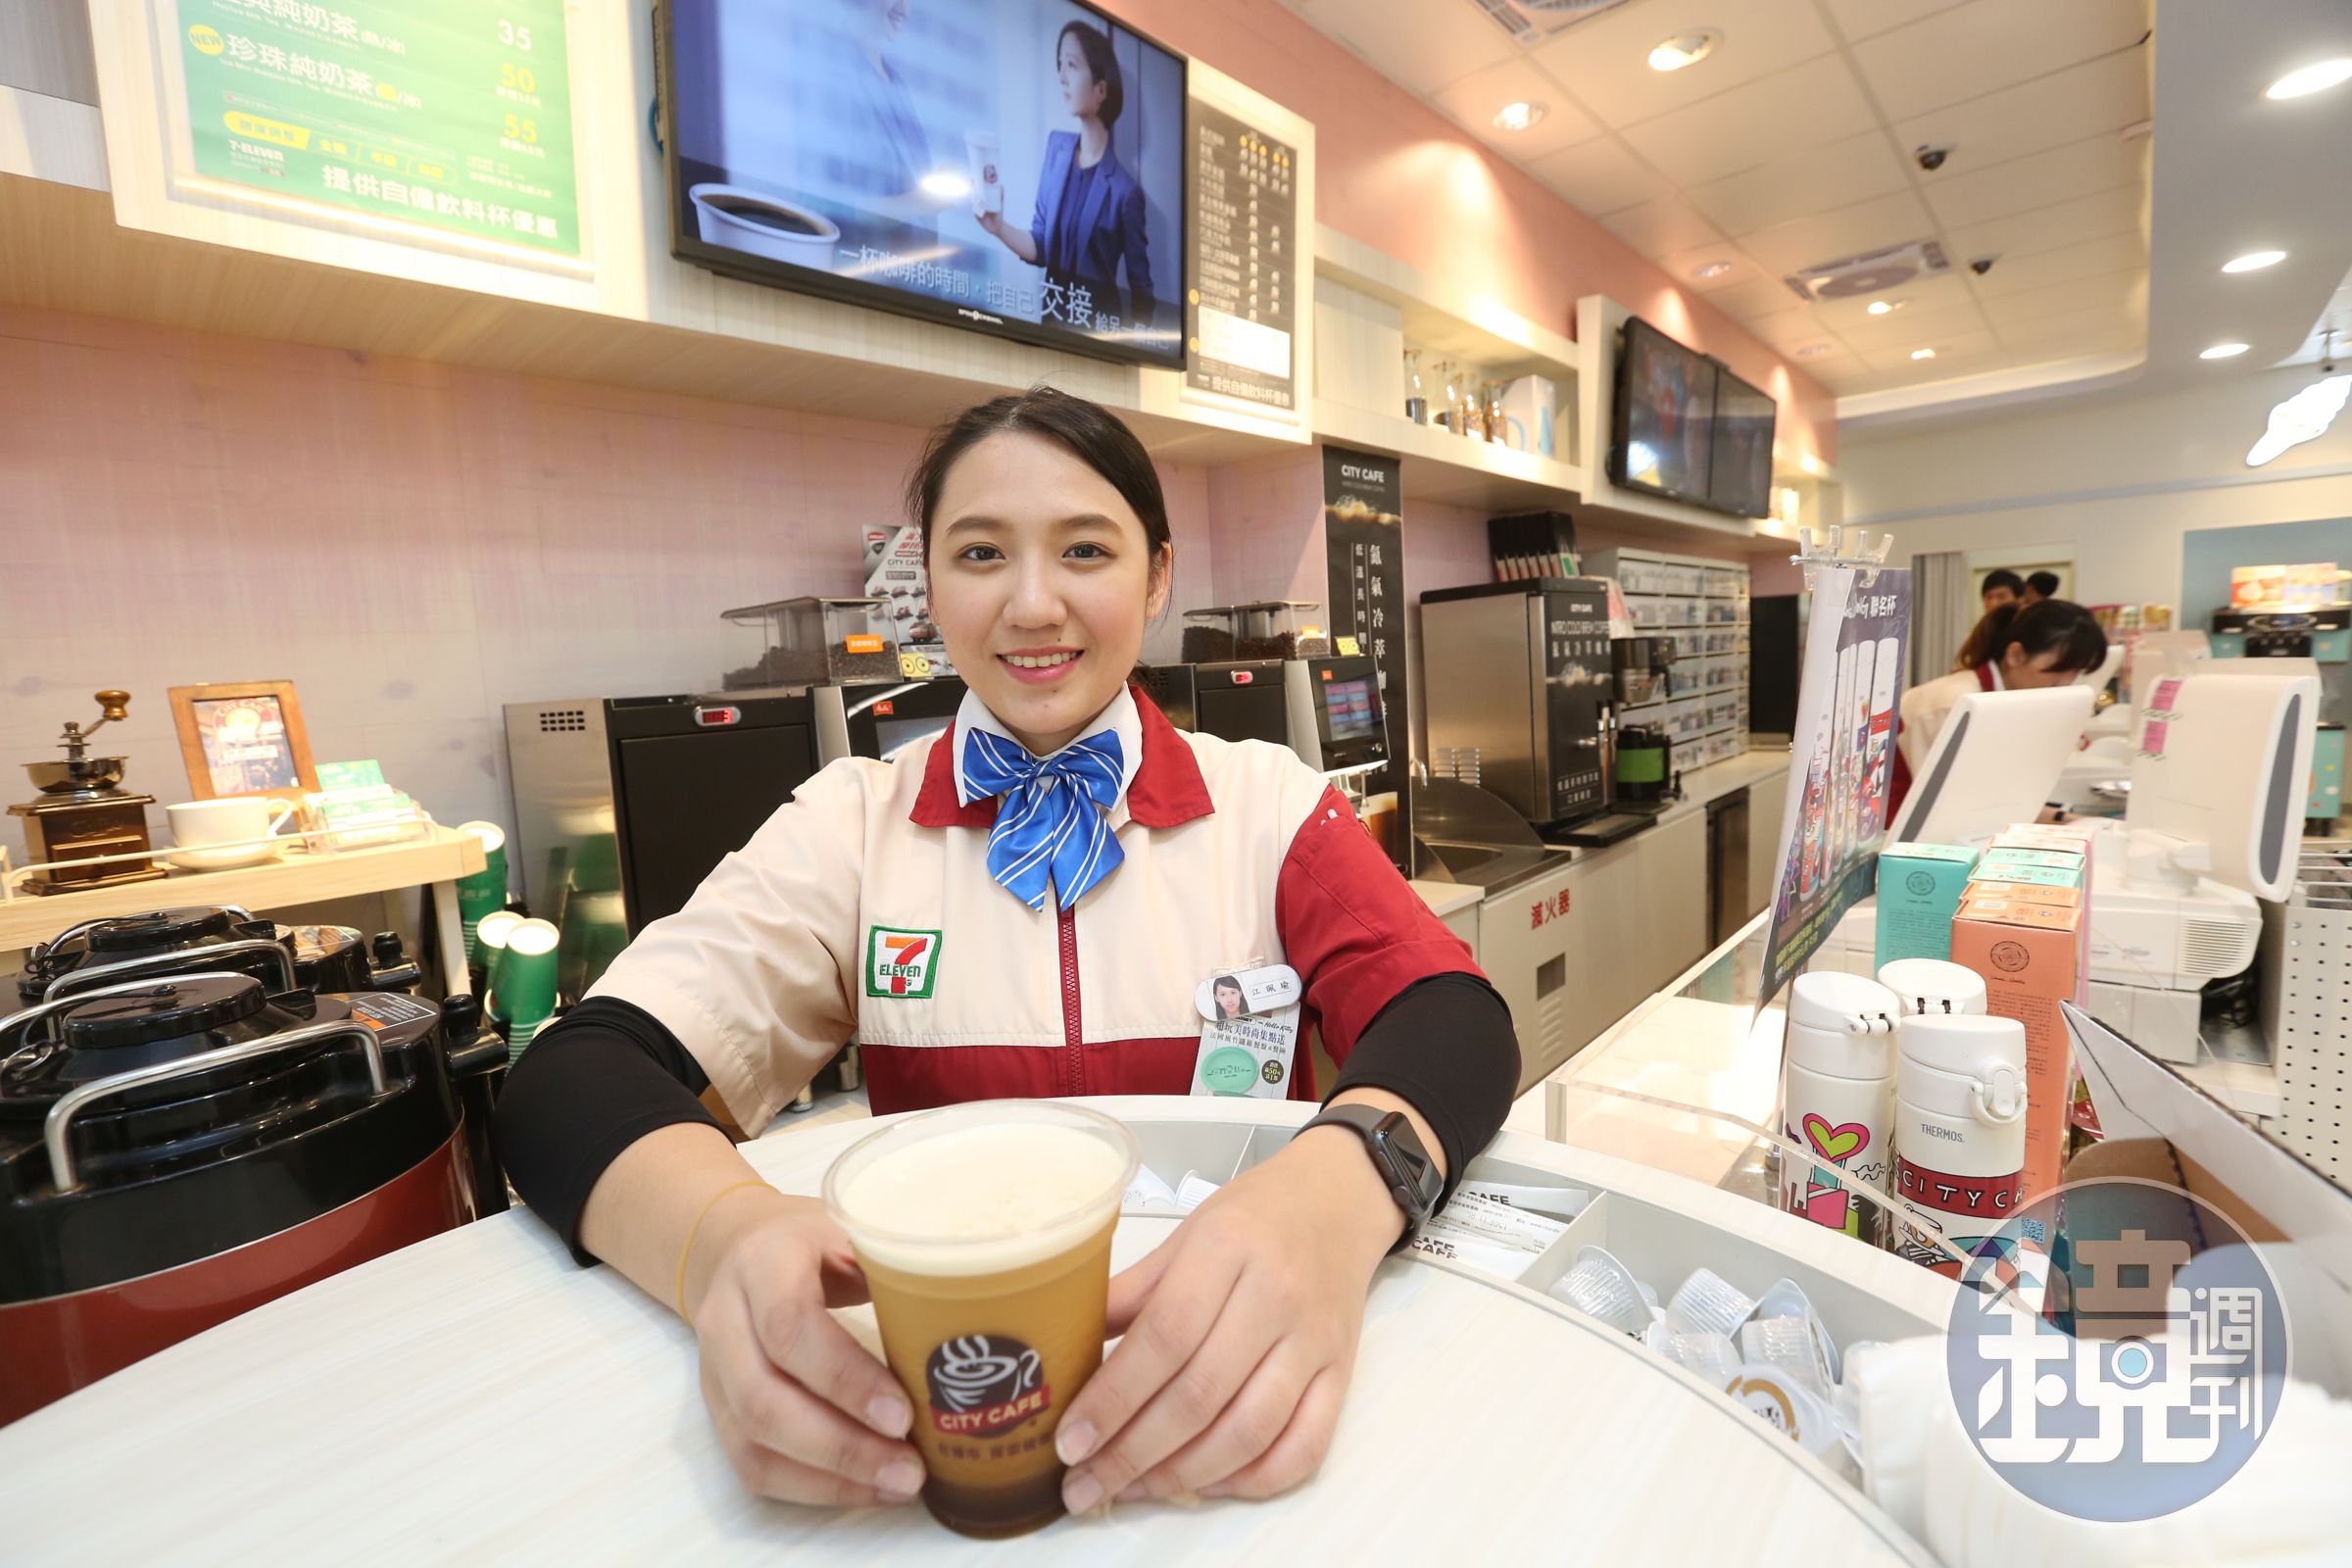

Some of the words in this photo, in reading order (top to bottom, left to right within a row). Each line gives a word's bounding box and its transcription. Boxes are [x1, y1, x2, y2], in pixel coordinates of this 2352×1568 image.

[191, 33, 221, 47] NEW
[498, 20, 532, 50] 35
[226, 33, 373, 96] 珍珠純奶茶
[501, 63, 536, 93] 50
[504, 114, 537, 142] 55
[321, 165, 559, 238] 提供自備飲料杯優惠
[1341, 465, 1361, 478] CITY
[1361, 467, 1385, 483] CAFE
[1531, 888, 1571, 930] 滅火器
[1921, 1123, 1964, 1144] THERMOS
[1902, 1170, 1982, 1207] CITY
[939, 1412, 983, 1431] CITY
[988, 1391, 1042, 1425] CAFE
